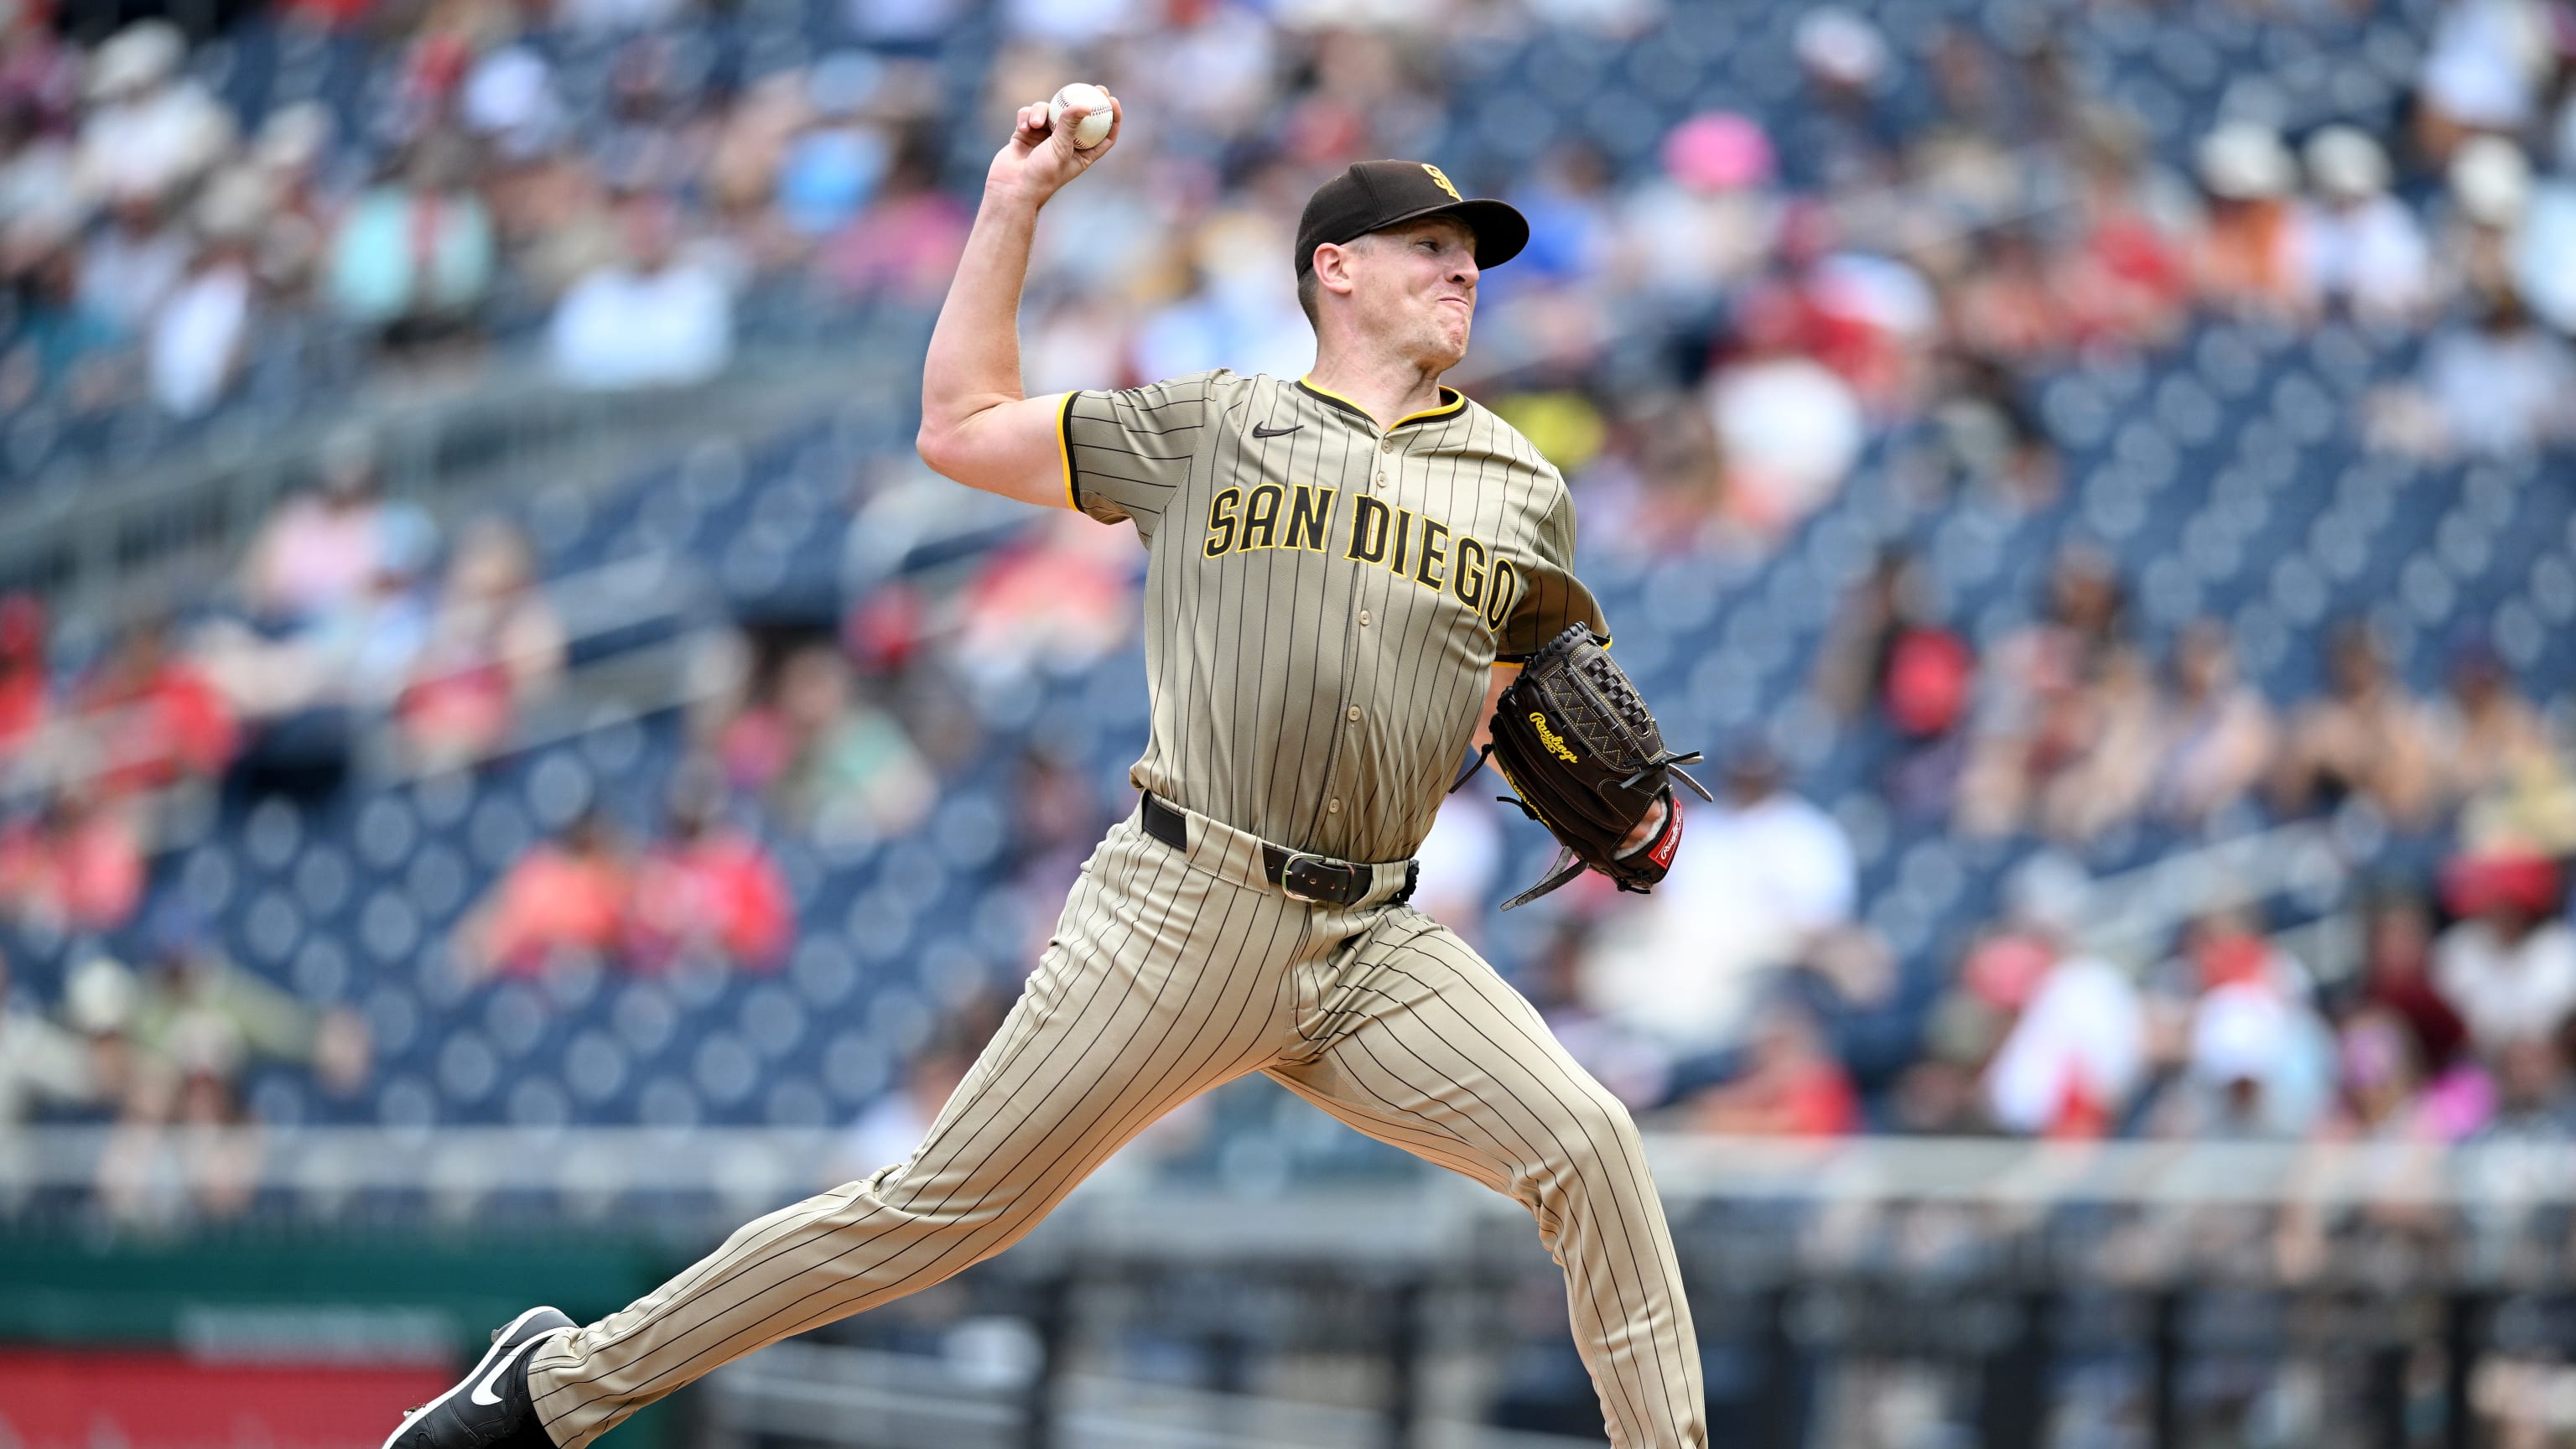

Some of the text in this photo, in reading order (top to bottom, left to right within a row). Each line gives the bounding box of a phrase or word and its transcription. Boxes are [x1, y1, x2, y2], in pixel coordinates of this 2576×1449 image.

[1204, 483, 1516, 632] SAN DIEGO
[1529, 712, 1578, 763] Rawlings
